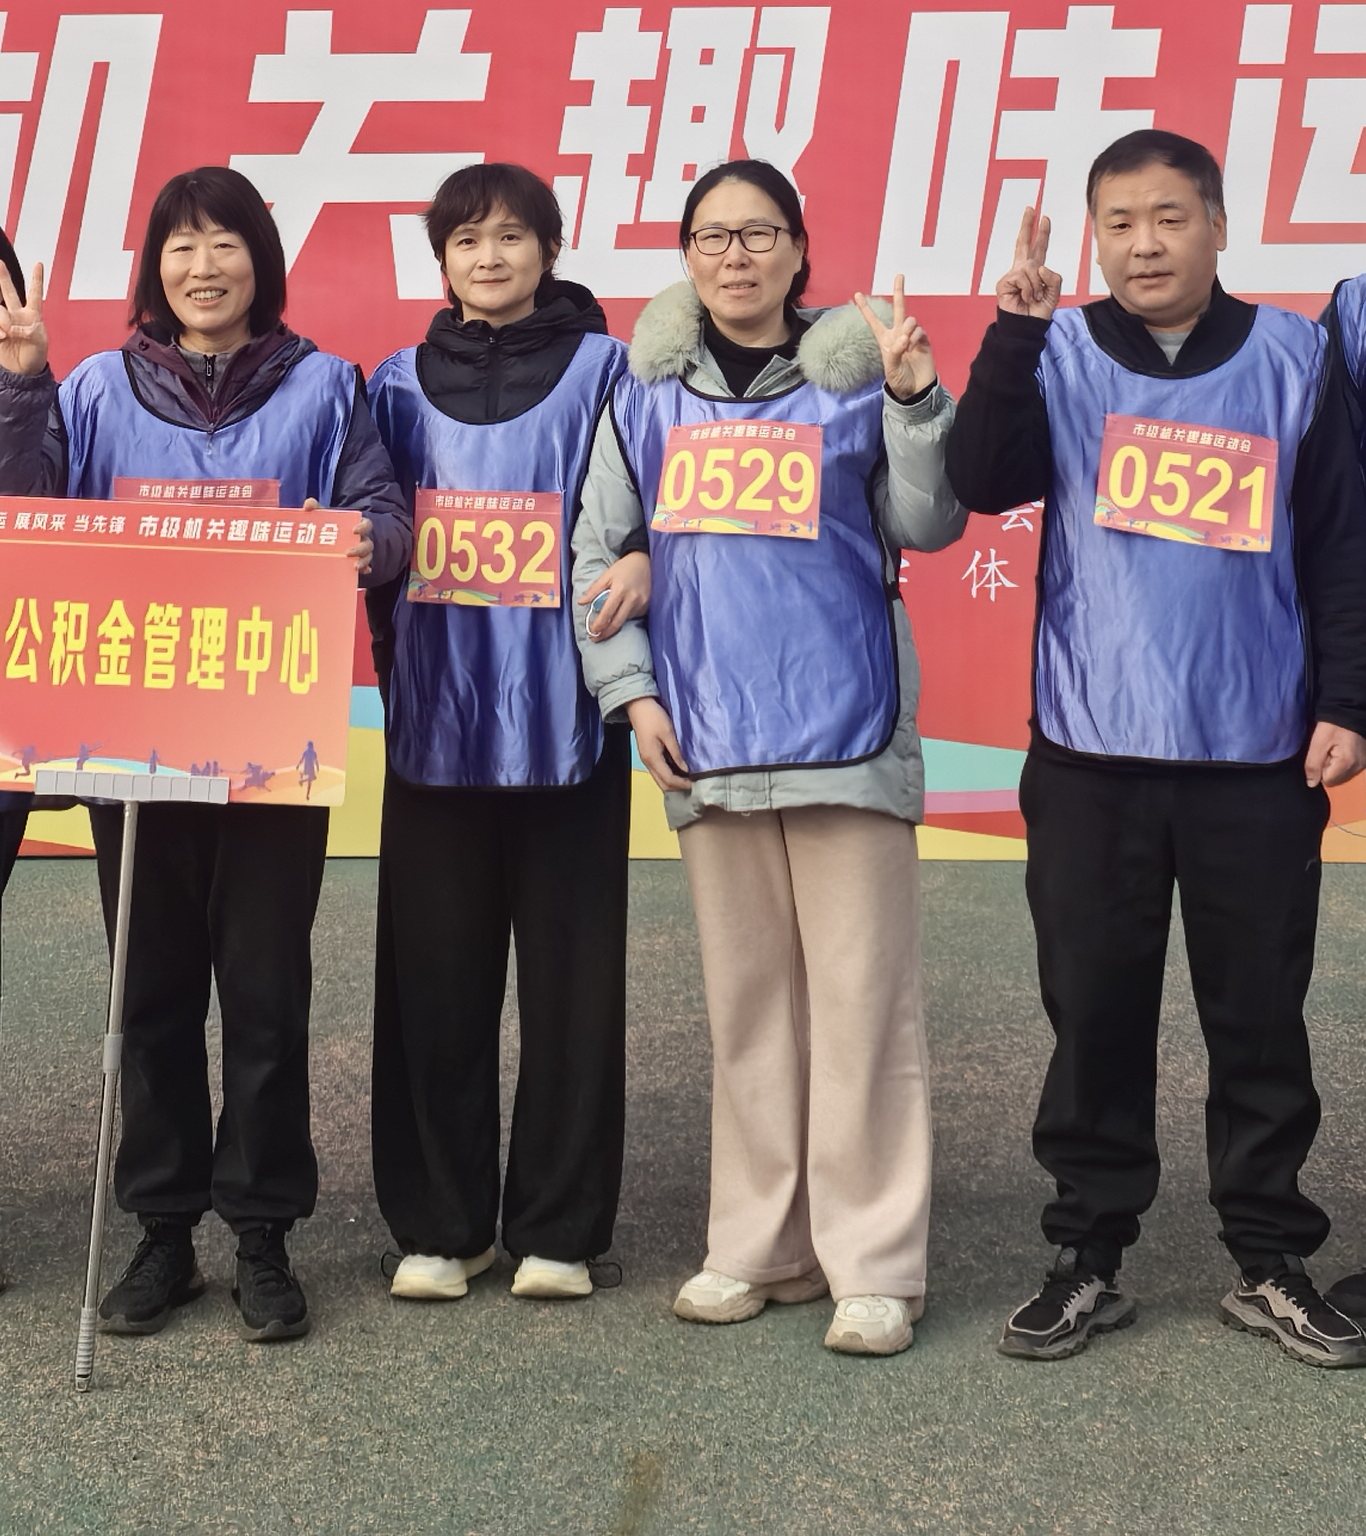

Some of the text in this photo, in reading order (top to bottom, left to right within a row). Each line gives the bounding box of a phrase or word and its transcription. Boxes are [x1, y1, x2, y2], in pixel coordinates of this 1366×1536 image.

[138, 484, 253, 499] 市级机关趣味运动会
[663, 447, 815, 515] 0529
[1108, 445, 1266, 530] 0521
[14, 512, 68, 532] 展风采
[73, 514, 127, 535] 当先锋
[138, 515, 339, 546] 市级机关趣味运动会
[417, 517, 555, 584] 0532
